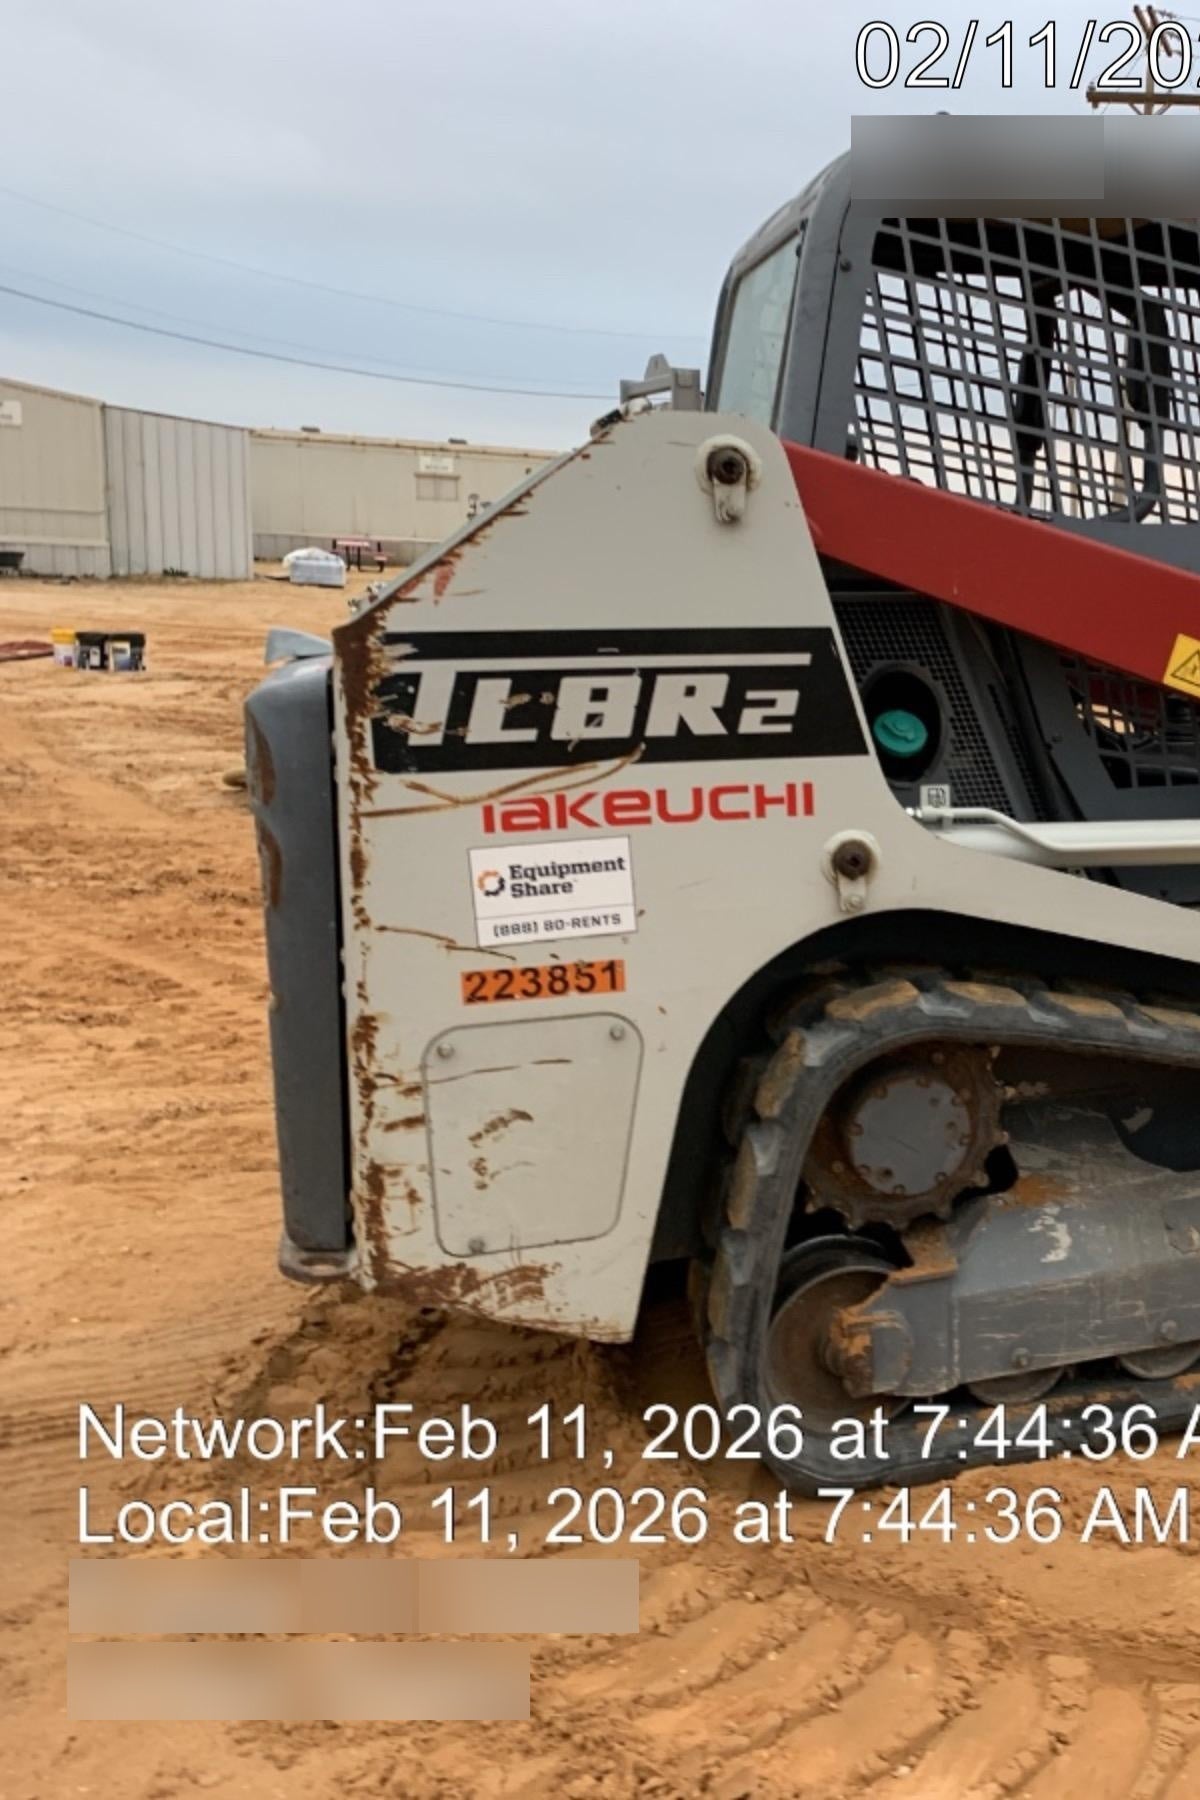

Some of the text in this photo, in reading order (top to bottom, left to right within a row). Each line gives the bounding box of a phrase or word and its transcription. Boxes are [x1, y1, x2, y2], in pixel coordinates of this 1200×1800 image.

[508, 857, 626, 881] Equipment
[510, 881, 574, 899] Share
[464, 960, 619, 1003] 223851
